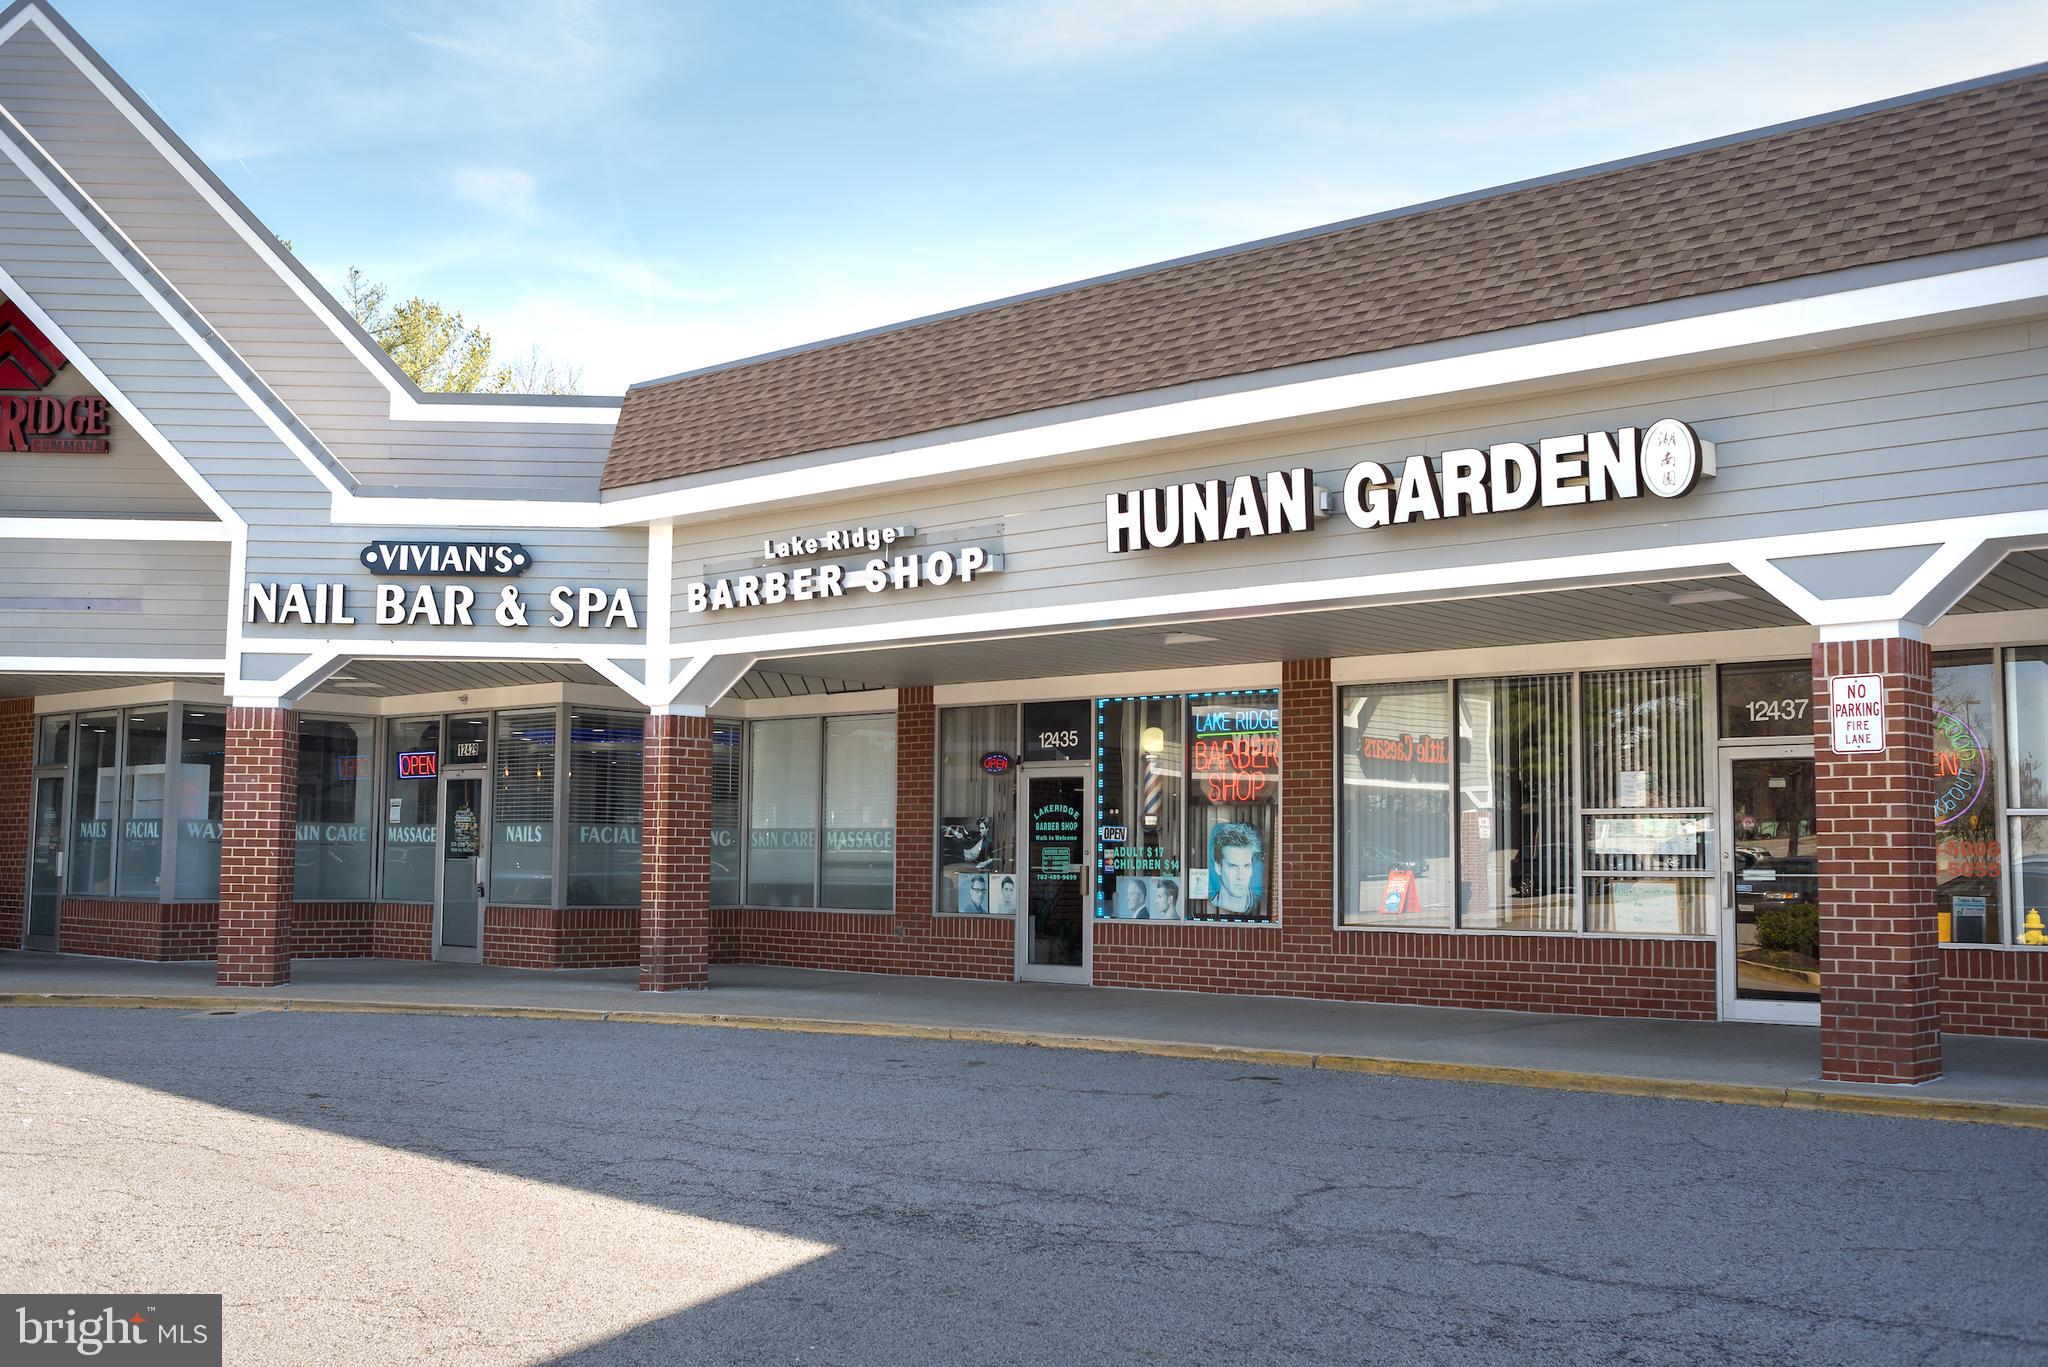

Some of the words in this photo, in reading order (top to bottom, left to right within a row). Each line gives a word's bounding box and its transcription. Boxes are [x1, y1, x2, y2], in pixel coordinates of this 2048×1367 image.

[0, 396, 109, 452] RIDGE
[1105, 468, 1312, 553] HUNAN
[1343, 427, 1644, 530] GARDEN
[764, 533, 819, 560] Lake
[826, 526, 897, 551] Ridge
[378, 544, 514, 573] VIVIAN'S
[687, 564, 846, 614] BARBER
[865, 546, 985, 593] SHOP
[247, 583, 357, 624] NAIL
[376, 585, 475, 626] BAR
[495, 585, 529, 627] &
[549, 585, 638, 628] SPA
[1847, 684, 1866, 698] NO
[1745, 698, 1809, 721] 12437
[1835, 702, 1880, 717] PARKING
[1196, 711, 1232, 731] LAKE
[1235, 709, 1278, 730] RIDGE
[1846, 720, 1869, 730] FIRE
[1039, 731, 1078, 748] 12435
[1845, 734, 1871, 744] LANE
[1195, 738, 1279, 770] BARBER
[401, 755, 436, 775] OPEN
[984, 758, 1008, 769] OPEN
[1208, 771, 1265, 801] SHOP
[1935, 768, 1975, 816] KEOUT
[1034, 804, 1080, 820] LAKERIDGE
[80, 822, 106, 838] NAILS
[125, 822, 159, 838] FACIAL
[295, 825, 320, 841] KIN
[325, 825, 368, 842] CARE
[388, 826, 437, 843] MASSAGE
[506, 826, 542, 842] NAILS
[580, 826, 640, 844] FACIAL
[1036, 822, 1059, 831] BARBER
[1061, 822, 1078, 831] SHOP
[1104, 828, 1125, 840] OPEN
[752, 831, 778, 847] SKIN
[782, 831, 815, 847] CARE
[827, 831, 892, 848] MASSAGE
[1113, 846, 1144, 857] ADULT
[1113, 859, 1160, 870] CHILDREN
